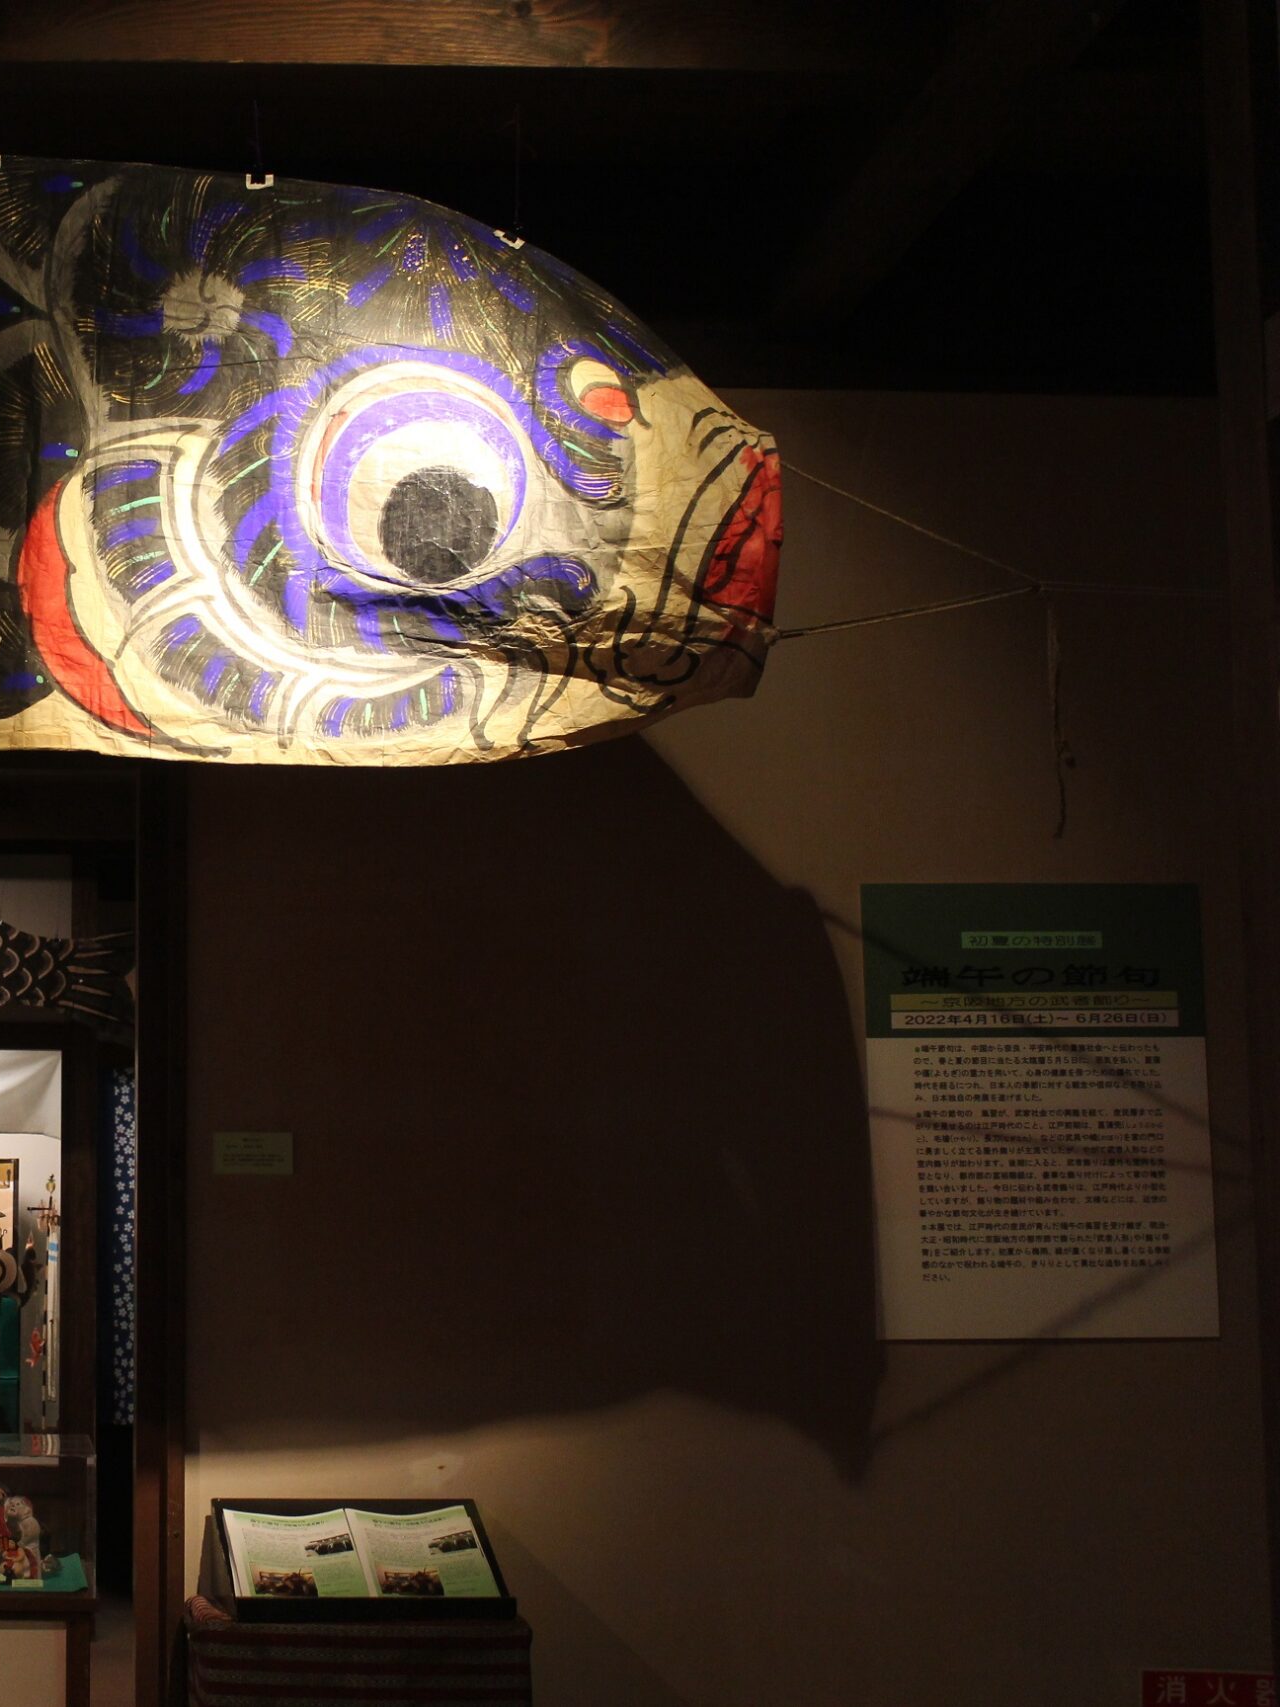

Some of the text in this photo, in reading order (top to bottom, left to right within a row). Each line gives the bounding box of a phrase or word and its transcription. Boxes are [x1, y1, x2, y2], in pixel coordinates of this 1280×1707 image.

[901, 963, 1160, 988] 端午の節句
[1155, 1674, 1274, 1706] 消火器
